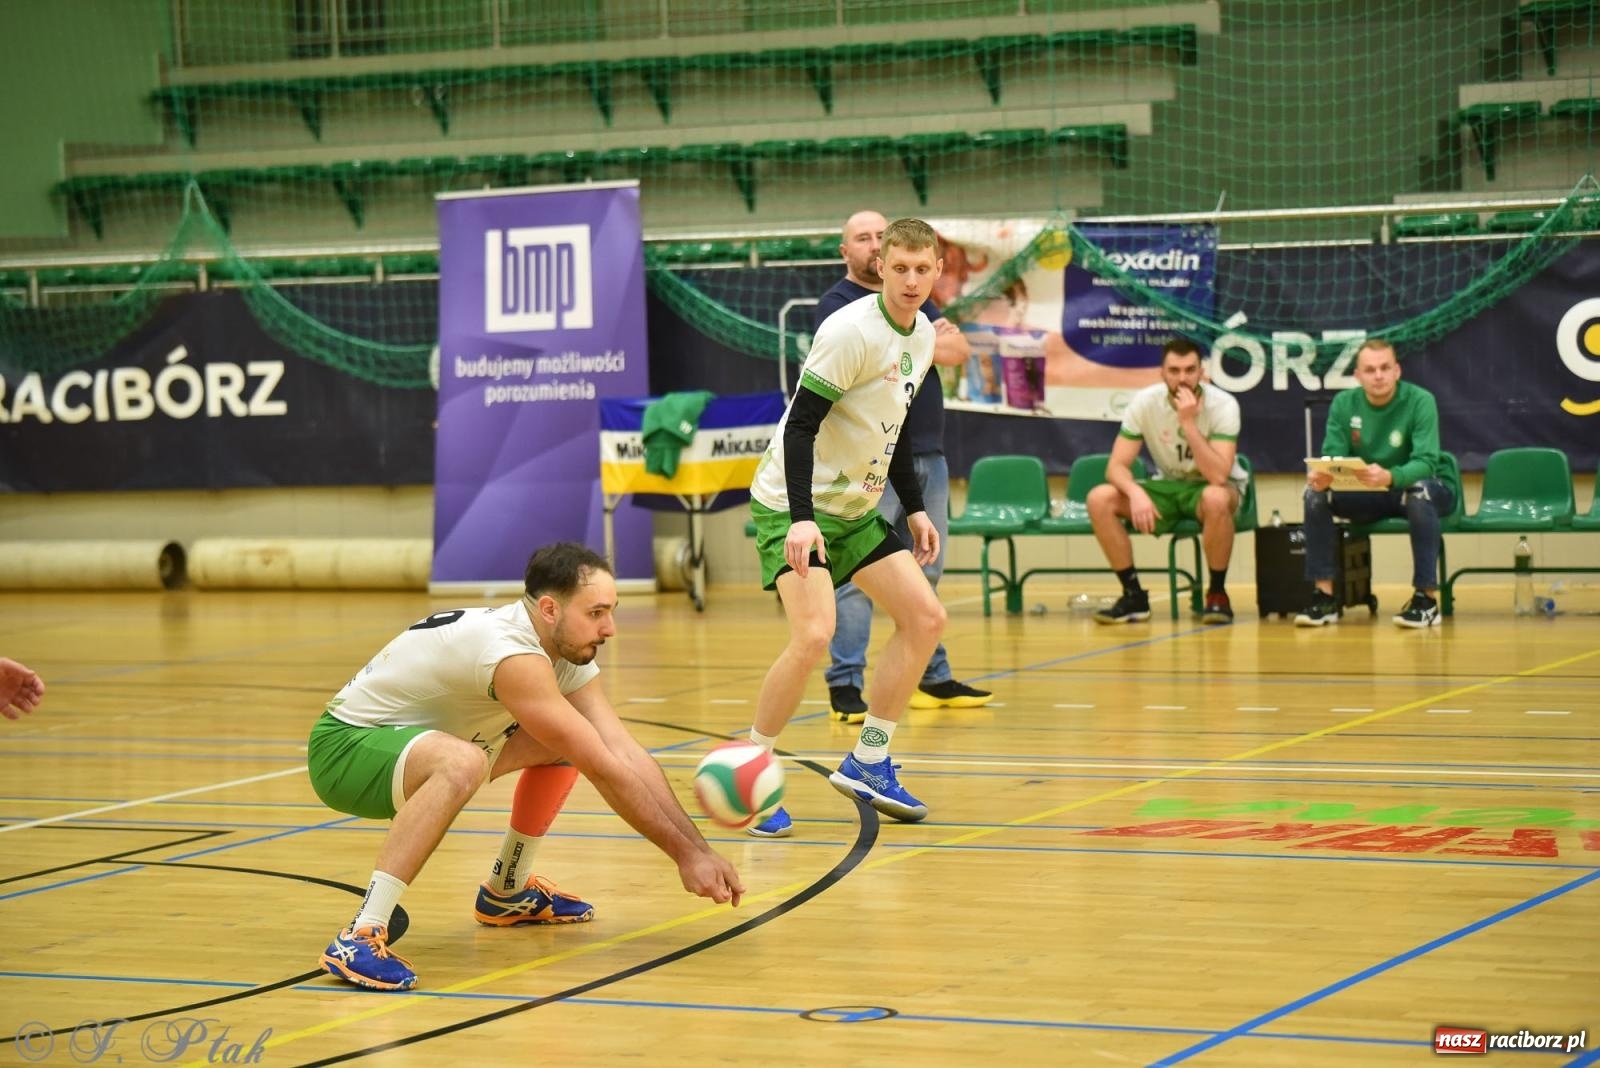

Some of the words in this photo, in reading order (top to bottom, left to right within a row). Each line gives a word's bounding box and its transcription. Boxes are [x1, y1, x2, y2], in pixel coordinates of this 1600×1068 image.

[486, 225, 593, 333] bmp
[455, 354, 534, 380] budujemy
[536, 350, 625, 374] możliwości
[0, 345, 287, 424] ACIBÓRZ
[485, 378, 596, 407] porozumienia
[408, 609, 466, 630] 9
